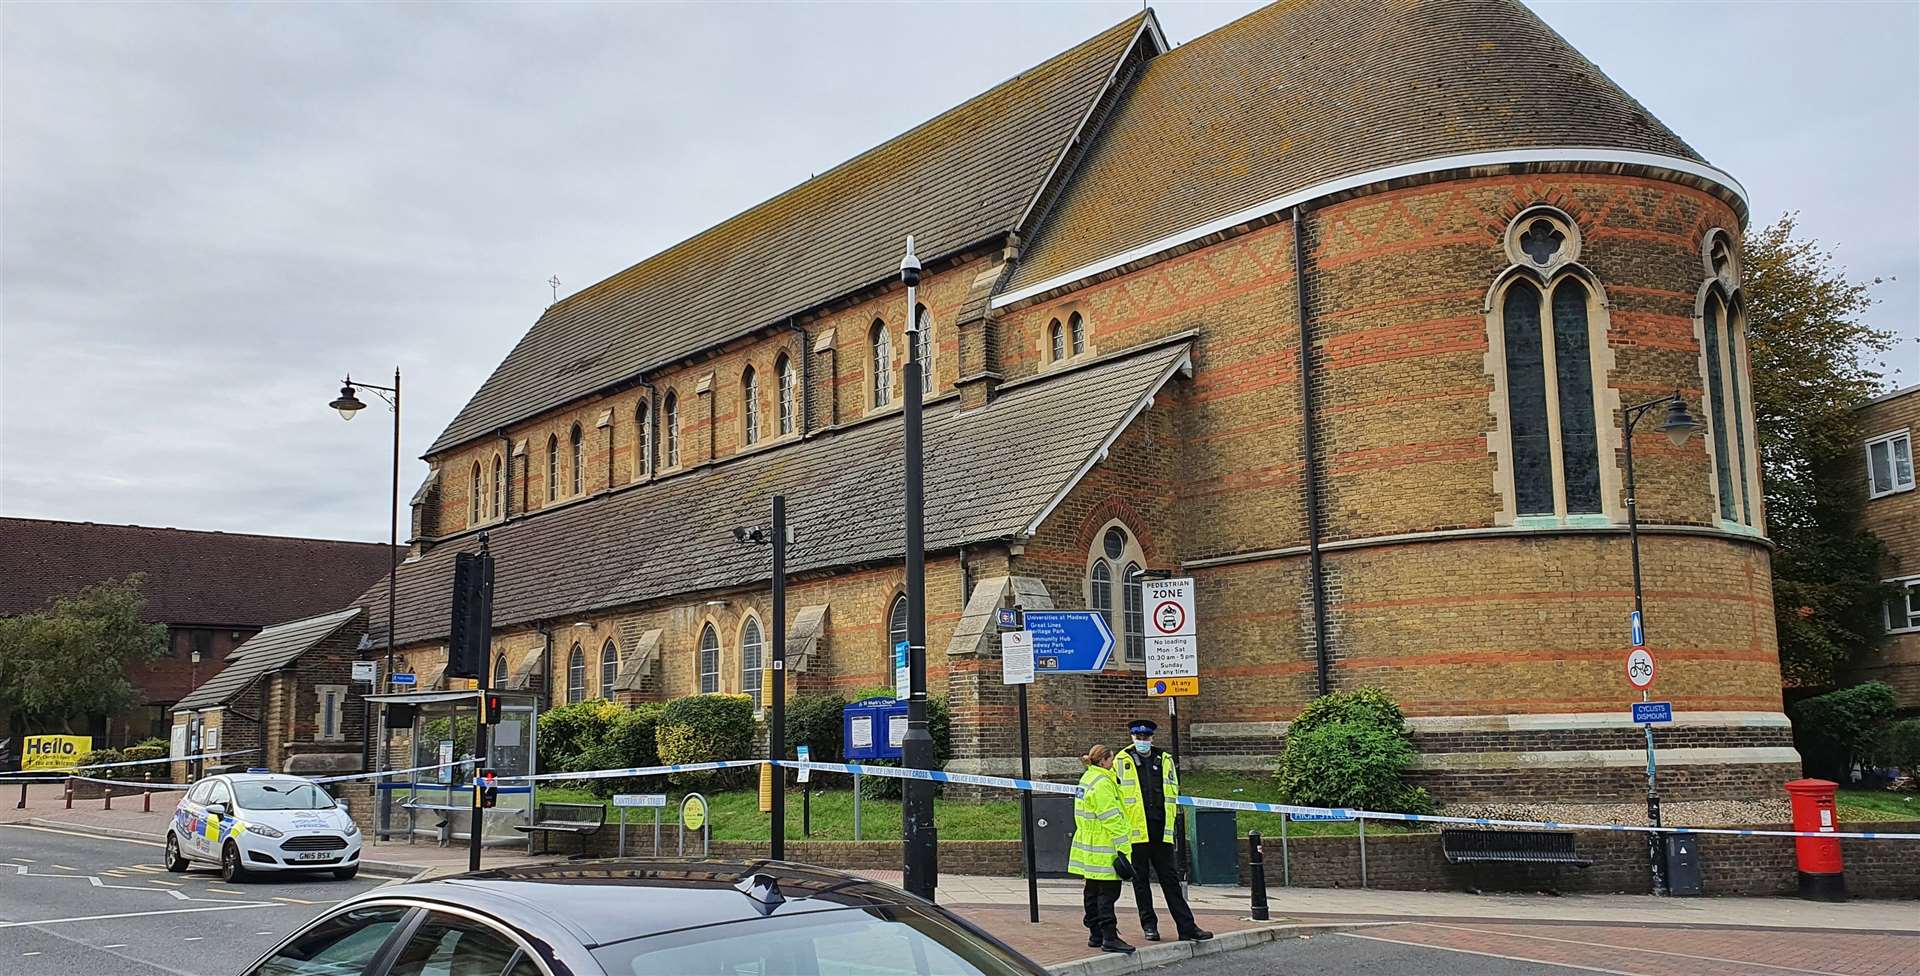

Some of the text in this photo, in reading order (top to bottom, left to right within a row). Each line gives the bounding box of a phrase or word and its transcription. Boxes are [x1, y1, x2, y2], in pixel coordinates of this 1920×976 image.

[1146, 580, 1190, 589] PEDESTRIAN
[1152, 588, 1184, 599] ZONE
[1638, 705, 1665, 713] CYCLISTS
[1636, 712, 1668, 720] DISMOUNT
[26, 738, 77, 755] Hello.
[866, 766, 883, 774] POLICE
[911, 770, 929, 778] CROSS
[951, 774, 968, 782] POLICE
[968, 775, 979, 783] LINE
[997, 778, 1013, 786] CROSS
